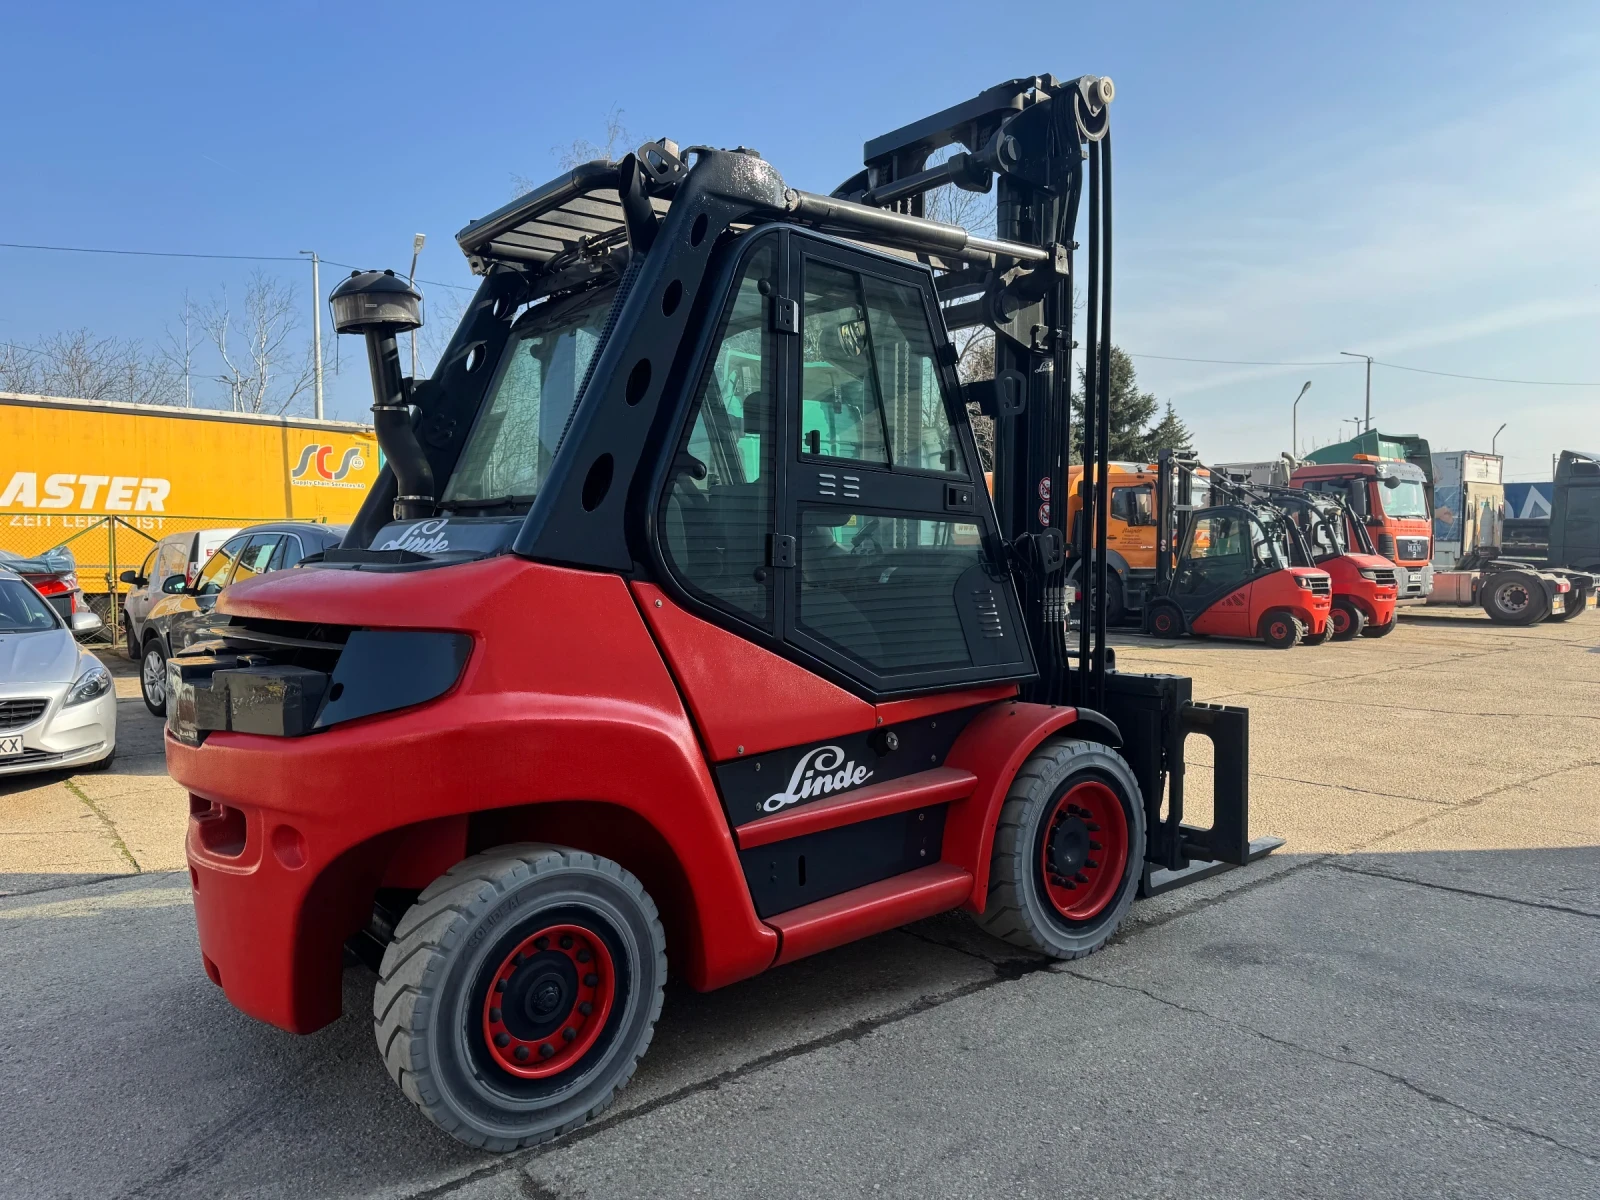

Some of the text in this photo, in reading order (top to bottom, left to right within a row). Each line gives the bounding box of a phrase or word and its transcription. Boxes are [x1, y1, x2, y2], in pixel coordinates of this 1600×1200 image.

[292, 444, 361, 480] SCS
[0, 471, 171, 511] ASTER
[292, 479, 313, 487] Supply
[10, 514, 51, 527] ZEIT
[137, 517, 166, 529] IST
[380, 518, 450, 554] Linde
[763, 745, 874, 812] Linde
